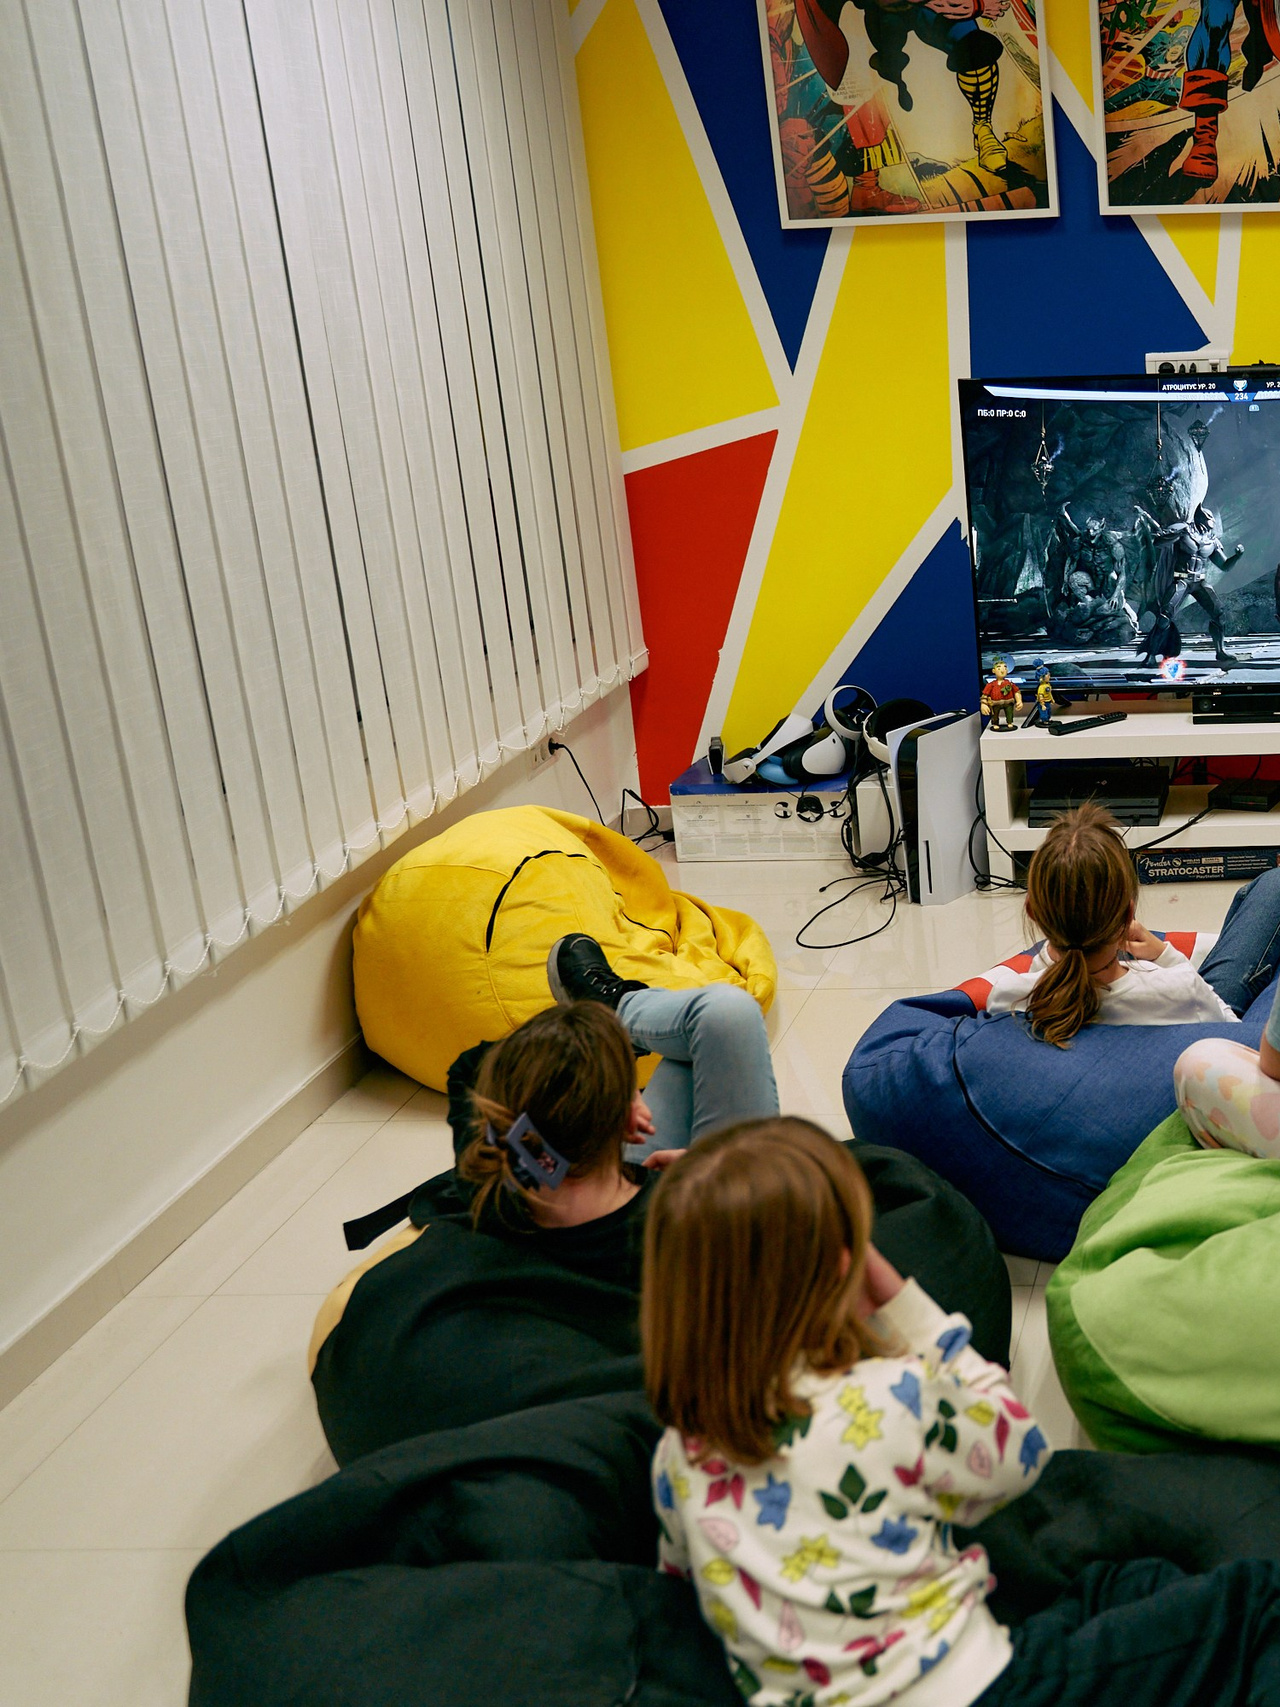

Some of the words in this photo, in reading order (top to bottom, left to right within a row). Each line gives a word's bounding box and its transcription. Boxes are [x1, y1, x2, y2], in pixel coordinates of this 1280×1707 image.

[1162, 383, 1197, 391] АТРОЦИТУС
[1208, 382, 1216, 390] 20
[1140, 856, 1171, 870] Fender
[1148, 865, 1224, 877] STRATOCASTER
